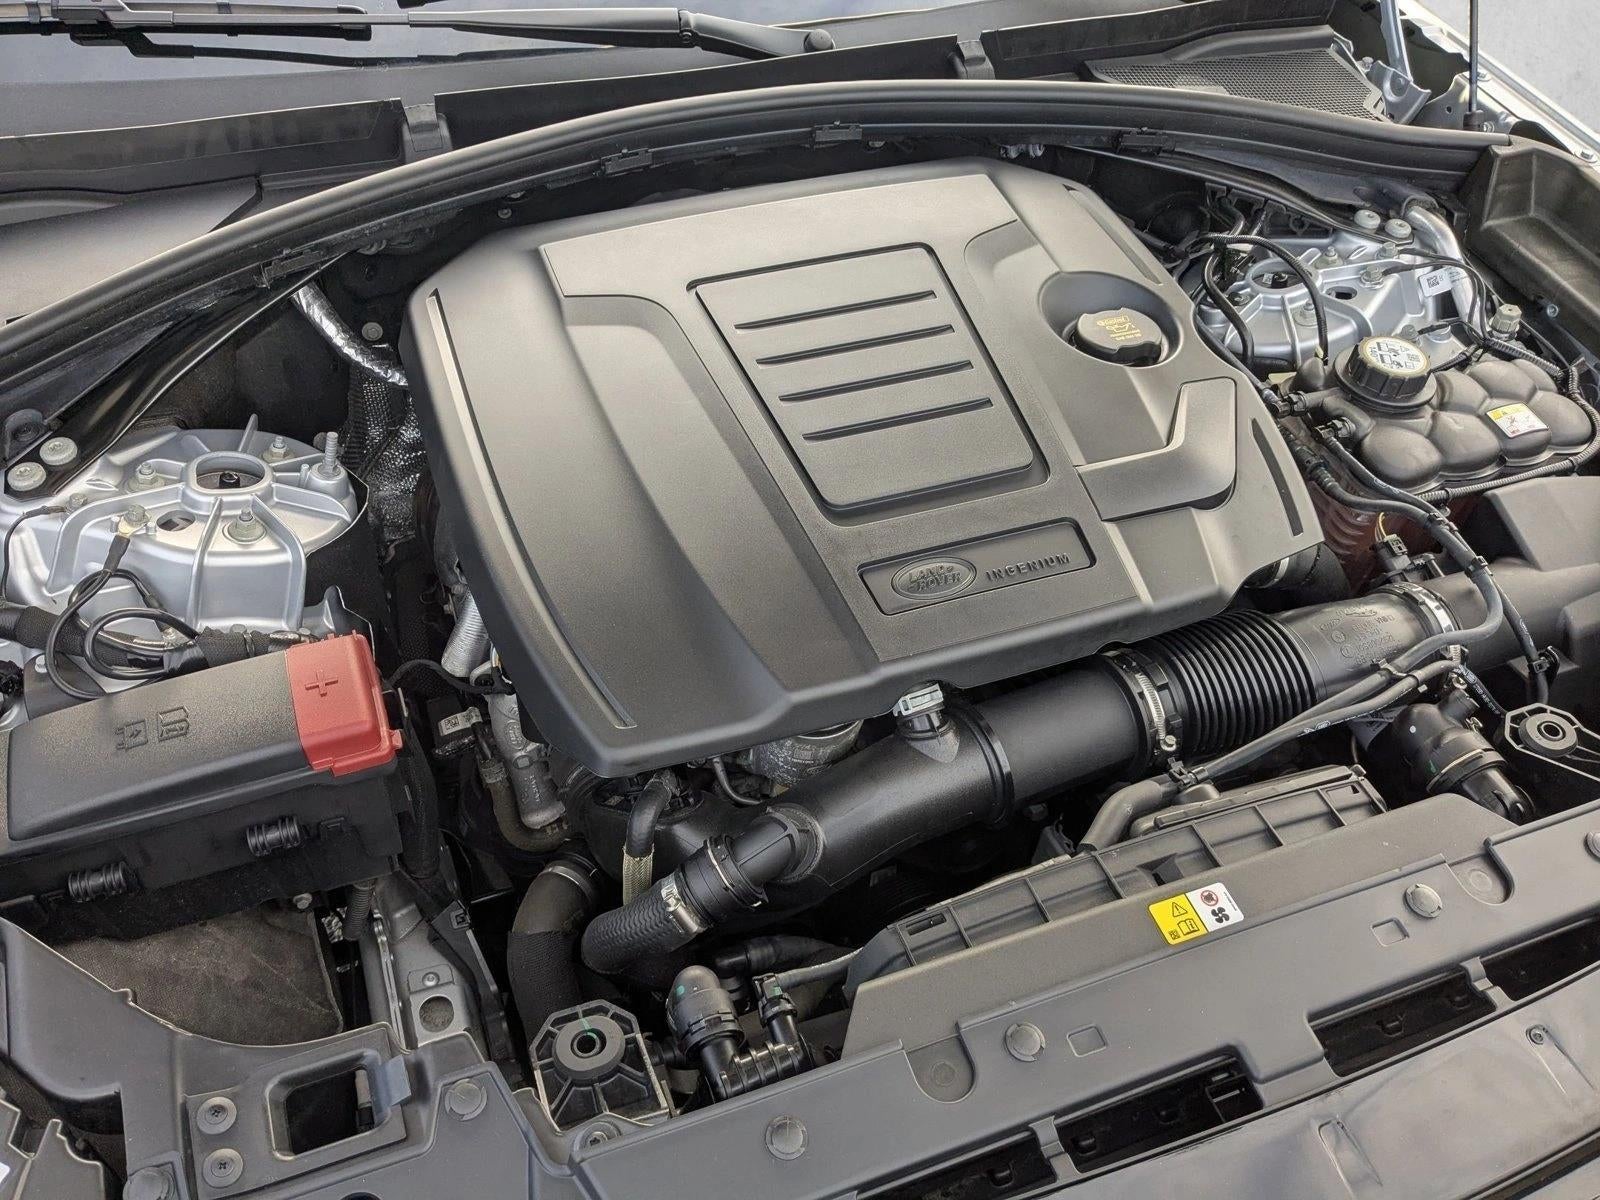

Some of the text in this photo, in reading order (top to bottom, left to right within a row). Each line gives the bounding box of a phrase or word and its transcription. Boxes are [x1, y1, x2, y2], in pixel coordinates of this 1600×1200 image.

[908, 564, 946, 583] LAND
[985, 553, 1071, 581] INGENIUM
[917, 571, 962, 591] ROVER
